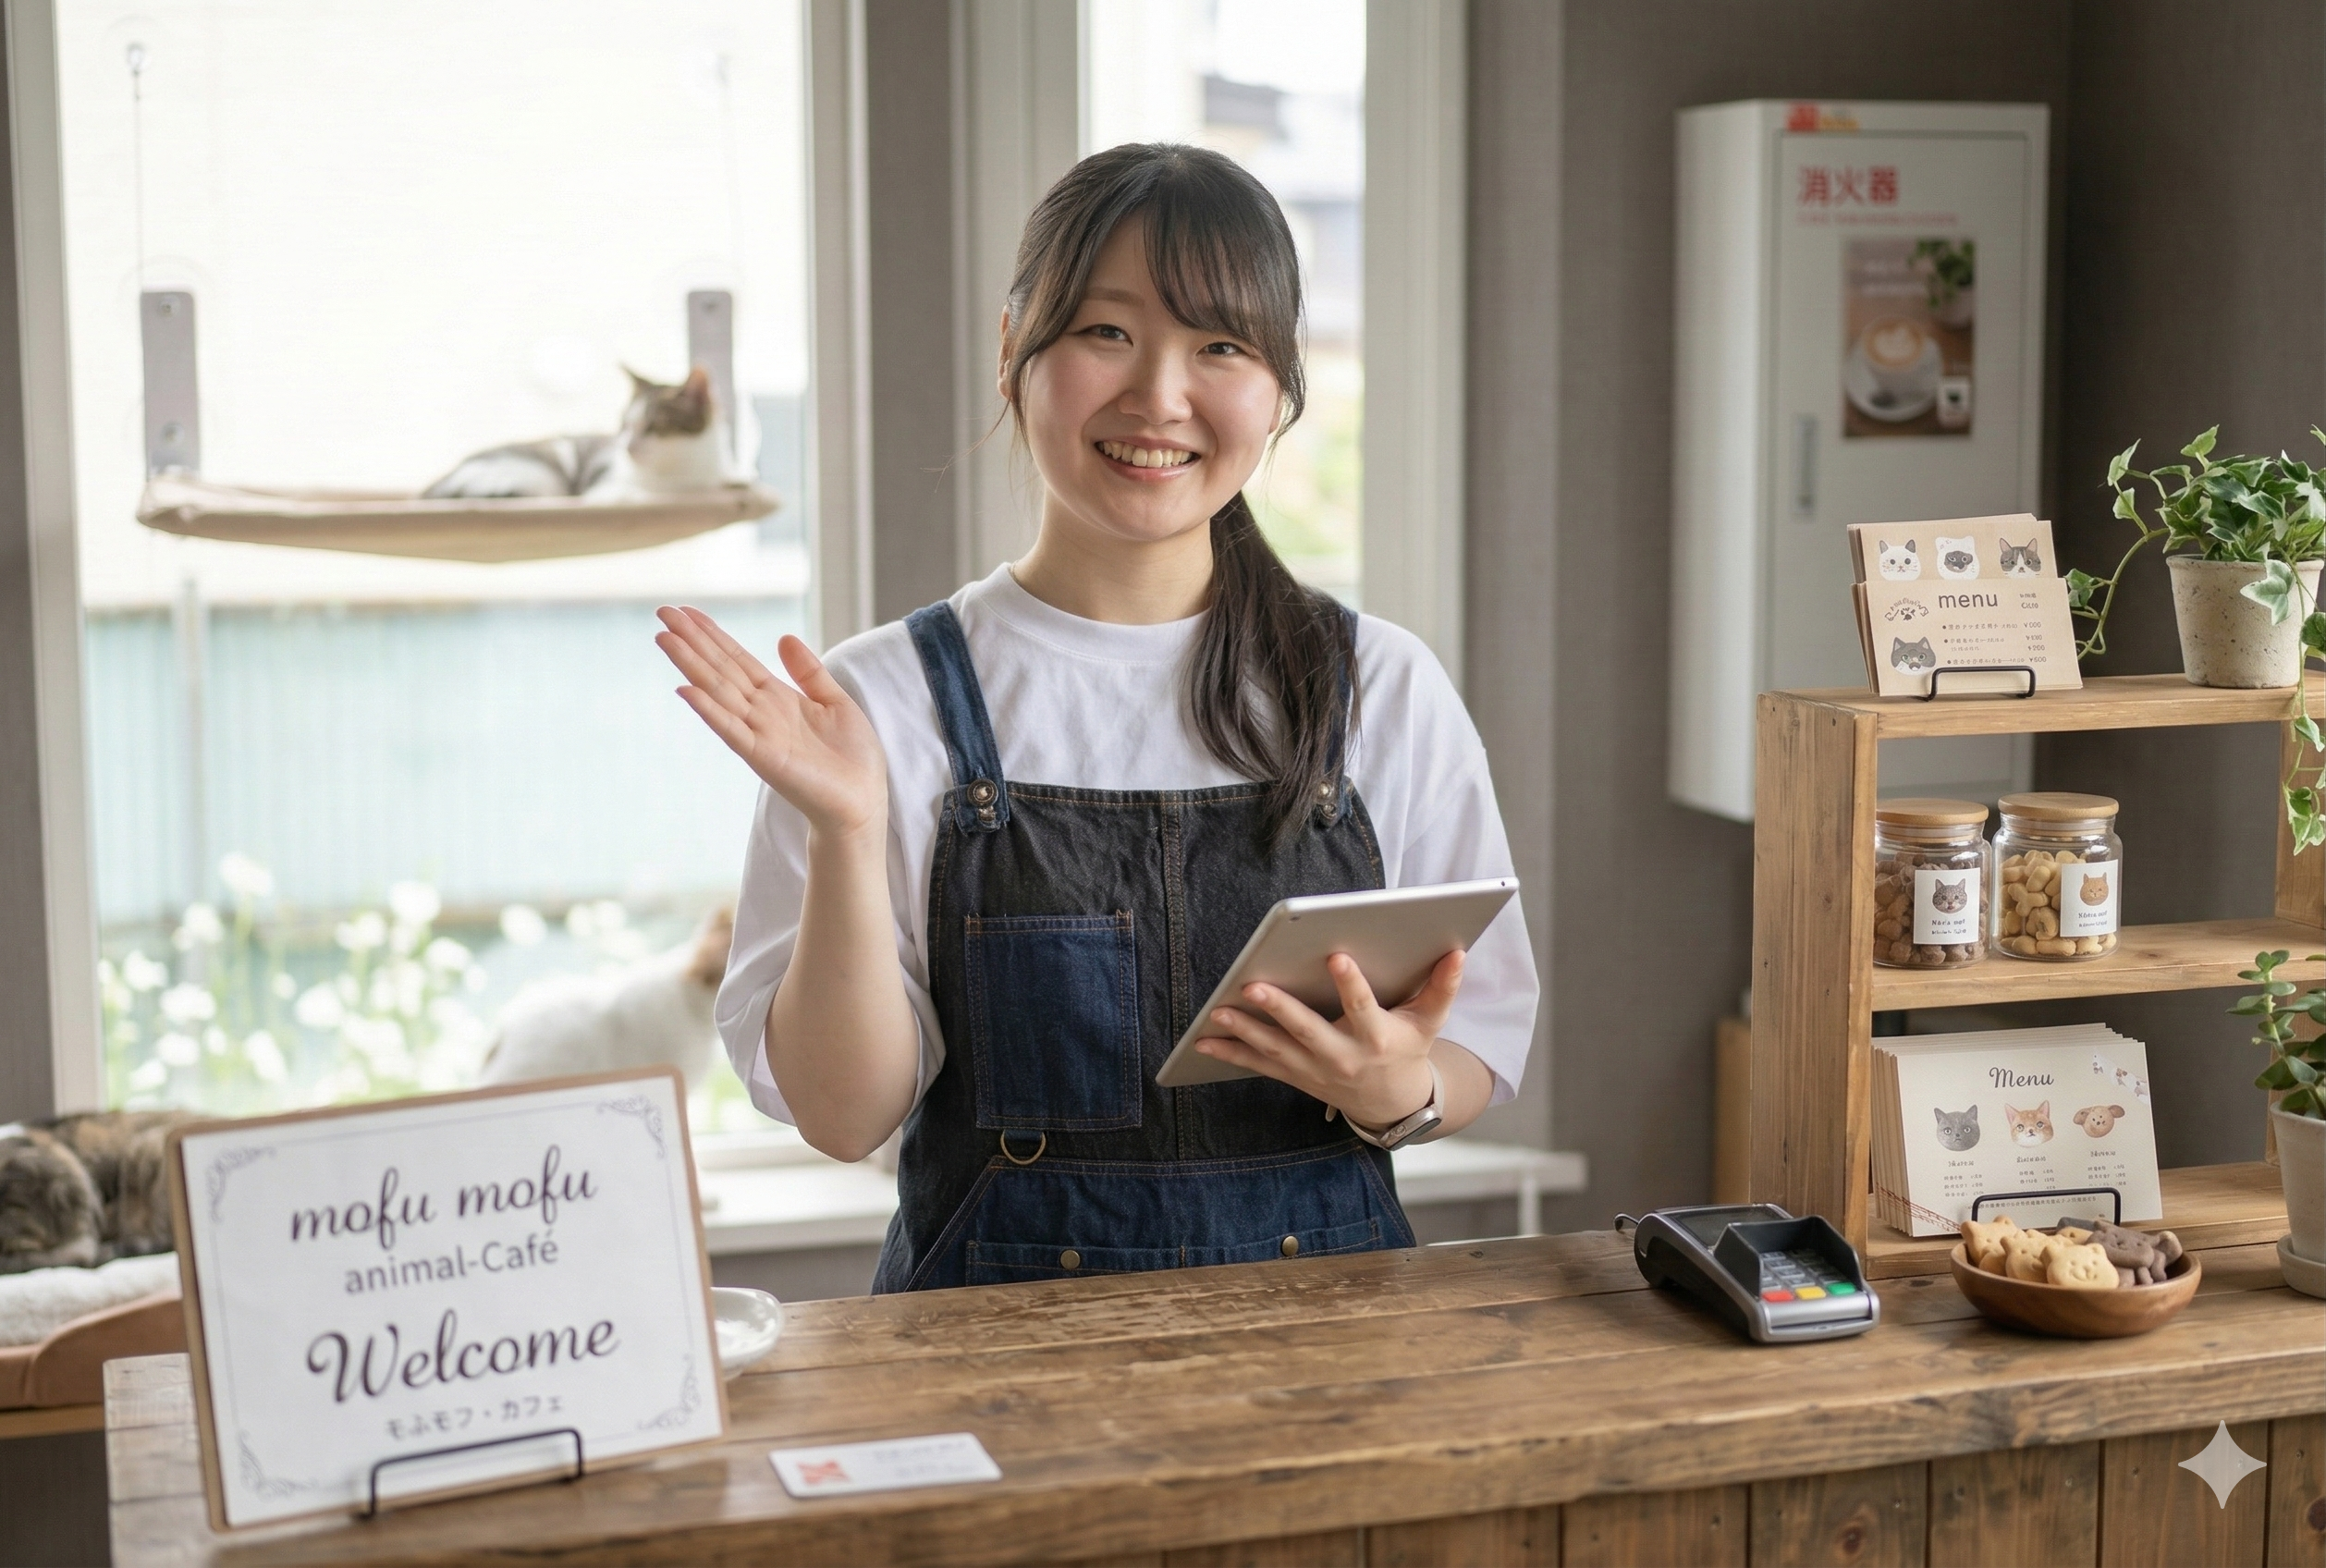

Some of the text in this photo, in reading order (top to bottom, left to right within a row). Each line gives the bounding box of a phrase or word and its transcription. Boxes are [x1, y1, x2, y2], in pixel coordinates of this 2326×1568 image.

[1798, 166, 1899, 205] 消火器
[1938, 593, 1998, 608] menu
[1989, 1067, 2054, 1088] Menu
[289, 1145, 599, 1249] mofu mofu
[344, 1230, 560, 1295] animal-Café
[304, 1308, 620, 1404] Welcome
